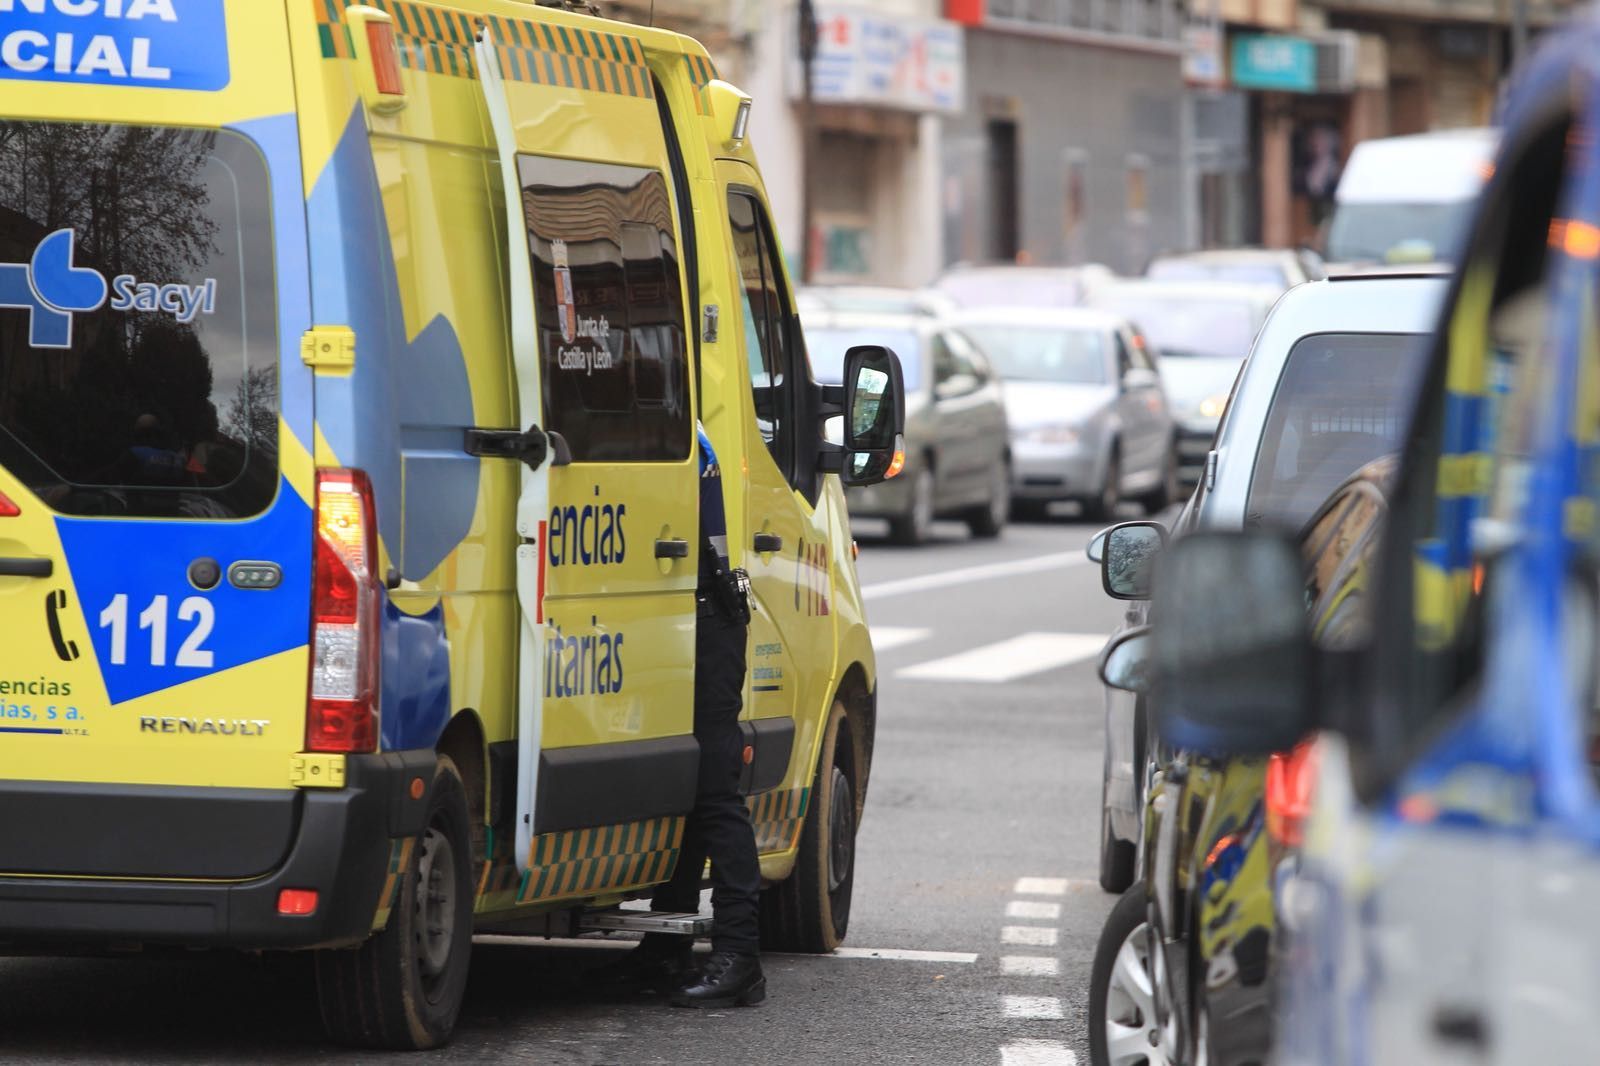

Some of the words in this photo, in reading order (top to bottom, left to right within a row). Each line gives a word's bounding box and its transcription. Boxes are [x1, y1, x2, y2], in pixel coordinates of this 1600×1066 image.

[1, 29, 171, 80] CIAL
[111, 274, 217, 322] Sacyl
[577, 314, 598, 337] Junta
[598, 314, 609, 337] de
[558, 346, 586, 369] Castilla
[586, 352, 593, 376] y
[548, 485, 626, 567] encias
[99, 593, 216, 668] 112
[546, 615, 624, 698] itarias
[0, 676, 72, 696] encias
[140, 716, 270, 736] RENAULT
